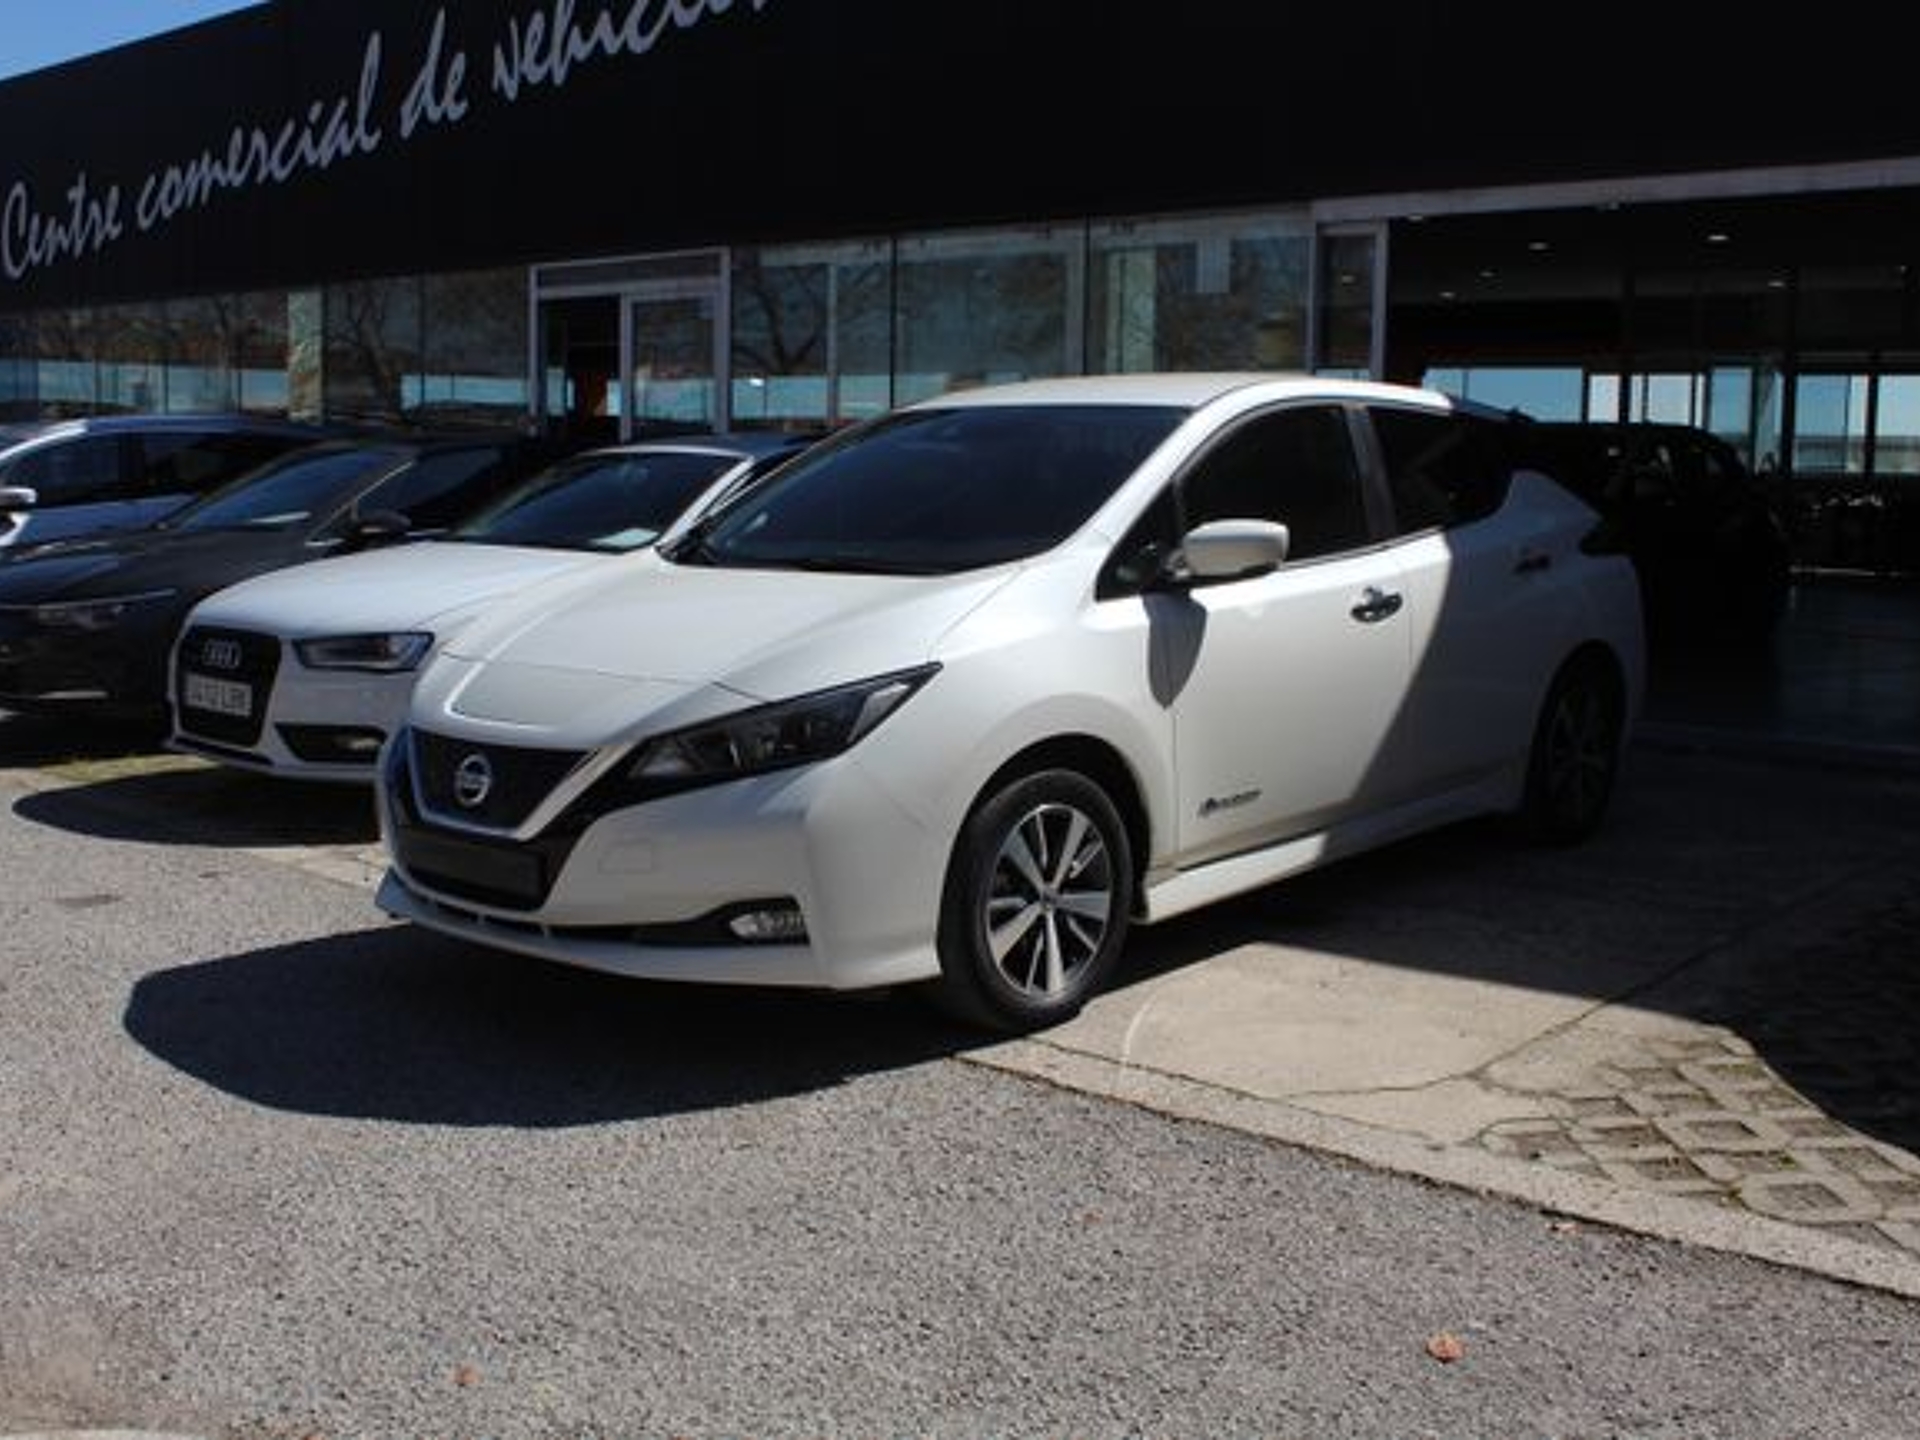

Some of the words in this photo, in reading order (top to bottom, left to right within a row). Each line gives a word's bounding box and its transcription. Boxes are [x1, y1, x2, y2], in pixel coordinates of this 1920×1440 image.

[1, 173, 122, 279] Centre
[136, 32, 381, 230] comercial
[400, 8, 468, 139] de
